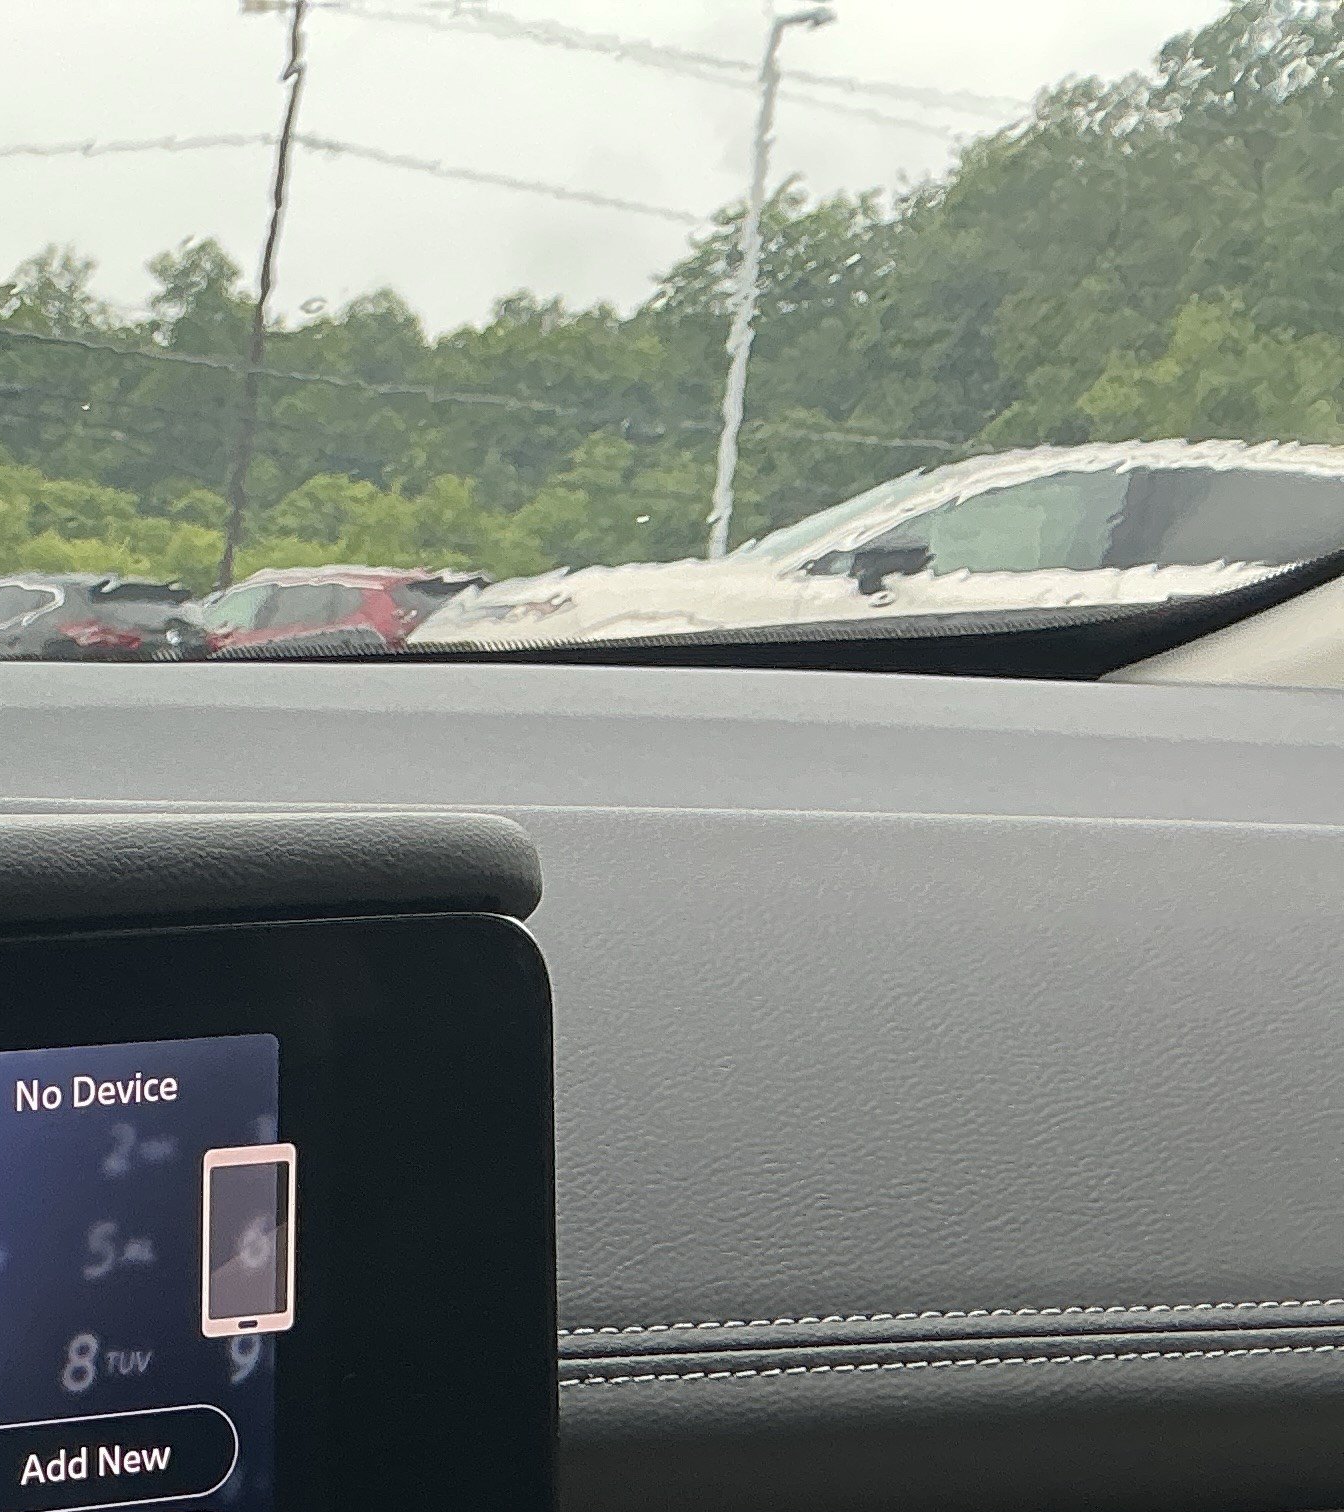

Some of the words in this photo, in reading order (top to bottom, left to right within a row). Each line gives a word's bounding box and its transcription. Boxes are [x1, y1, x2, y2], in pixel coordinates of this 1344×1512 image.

[15, 1079, 62, 1112] No
[72, 1072, 179, 1108] Device
[62, 1332, 98, 1394] 8
[19, 1447, 88, 1486] Add
[98, 1445, 172, 1476] New
